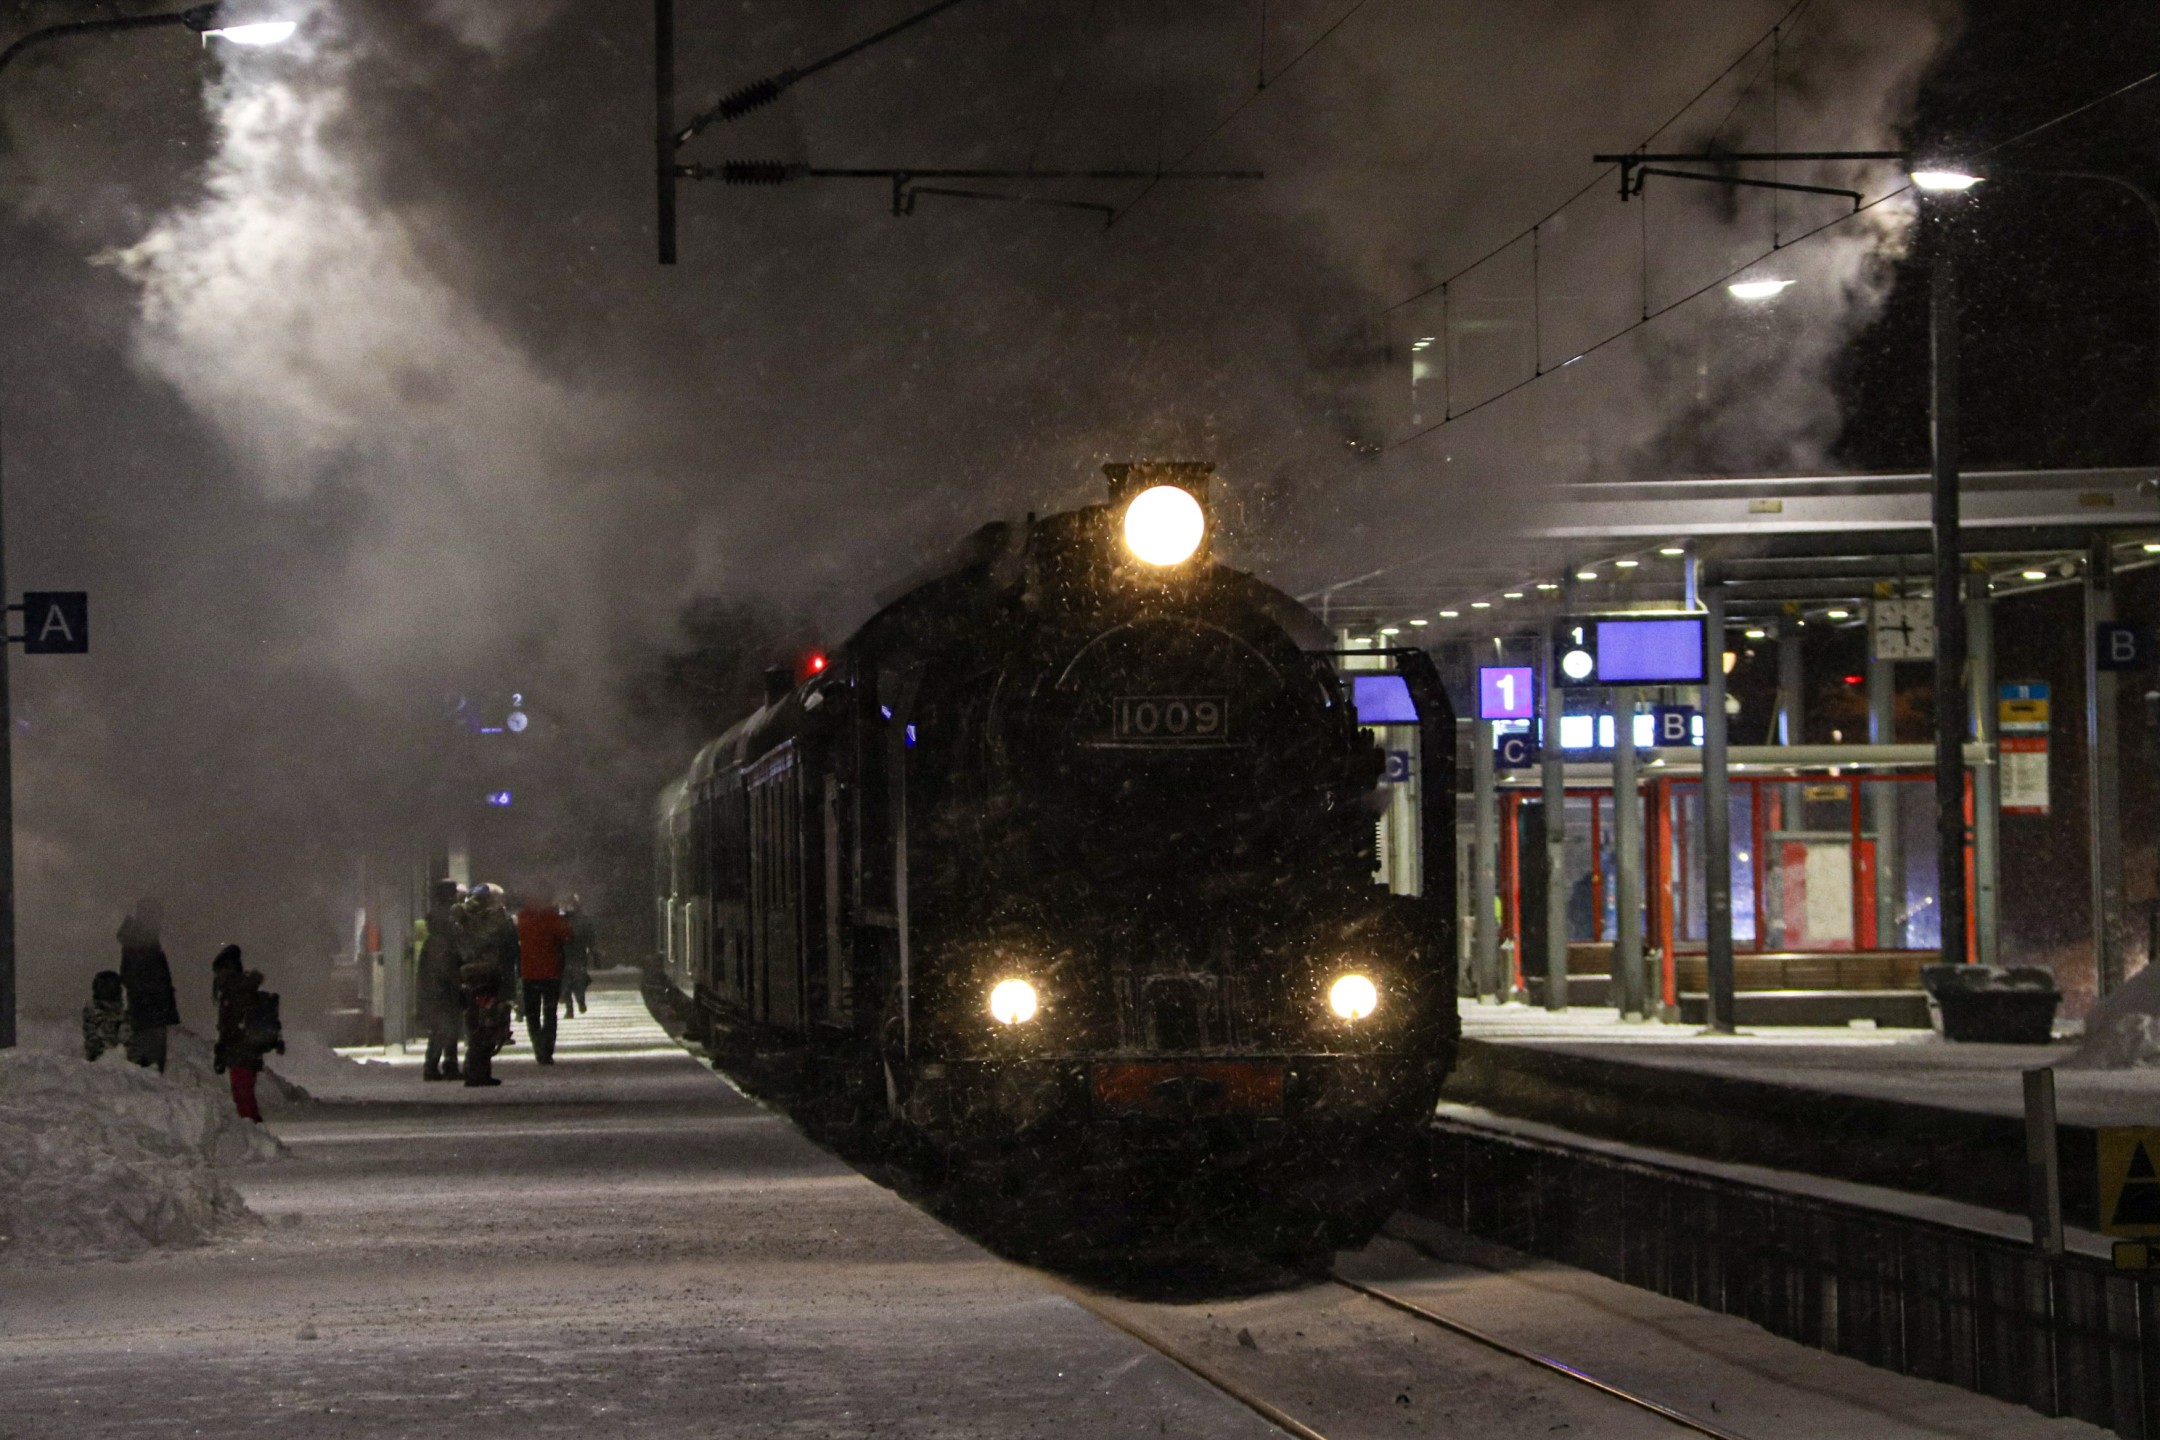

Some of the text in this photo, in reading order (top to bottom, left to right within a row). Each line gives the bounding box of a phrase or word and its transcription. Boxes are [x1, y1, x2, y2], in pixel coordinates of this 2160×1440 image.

[39, 603, 74, 642] A
[1571, 626, 1584, 645] 1
[2111, 630, 2136, 662] B
[512, 692, 523, 706] 2
[1496, 674, 1514, 711] 1
[1121, 701, 1219, 734] 1009
[1663, 713, 1686, 740] B
[1503, 739, 1526, 763] C
